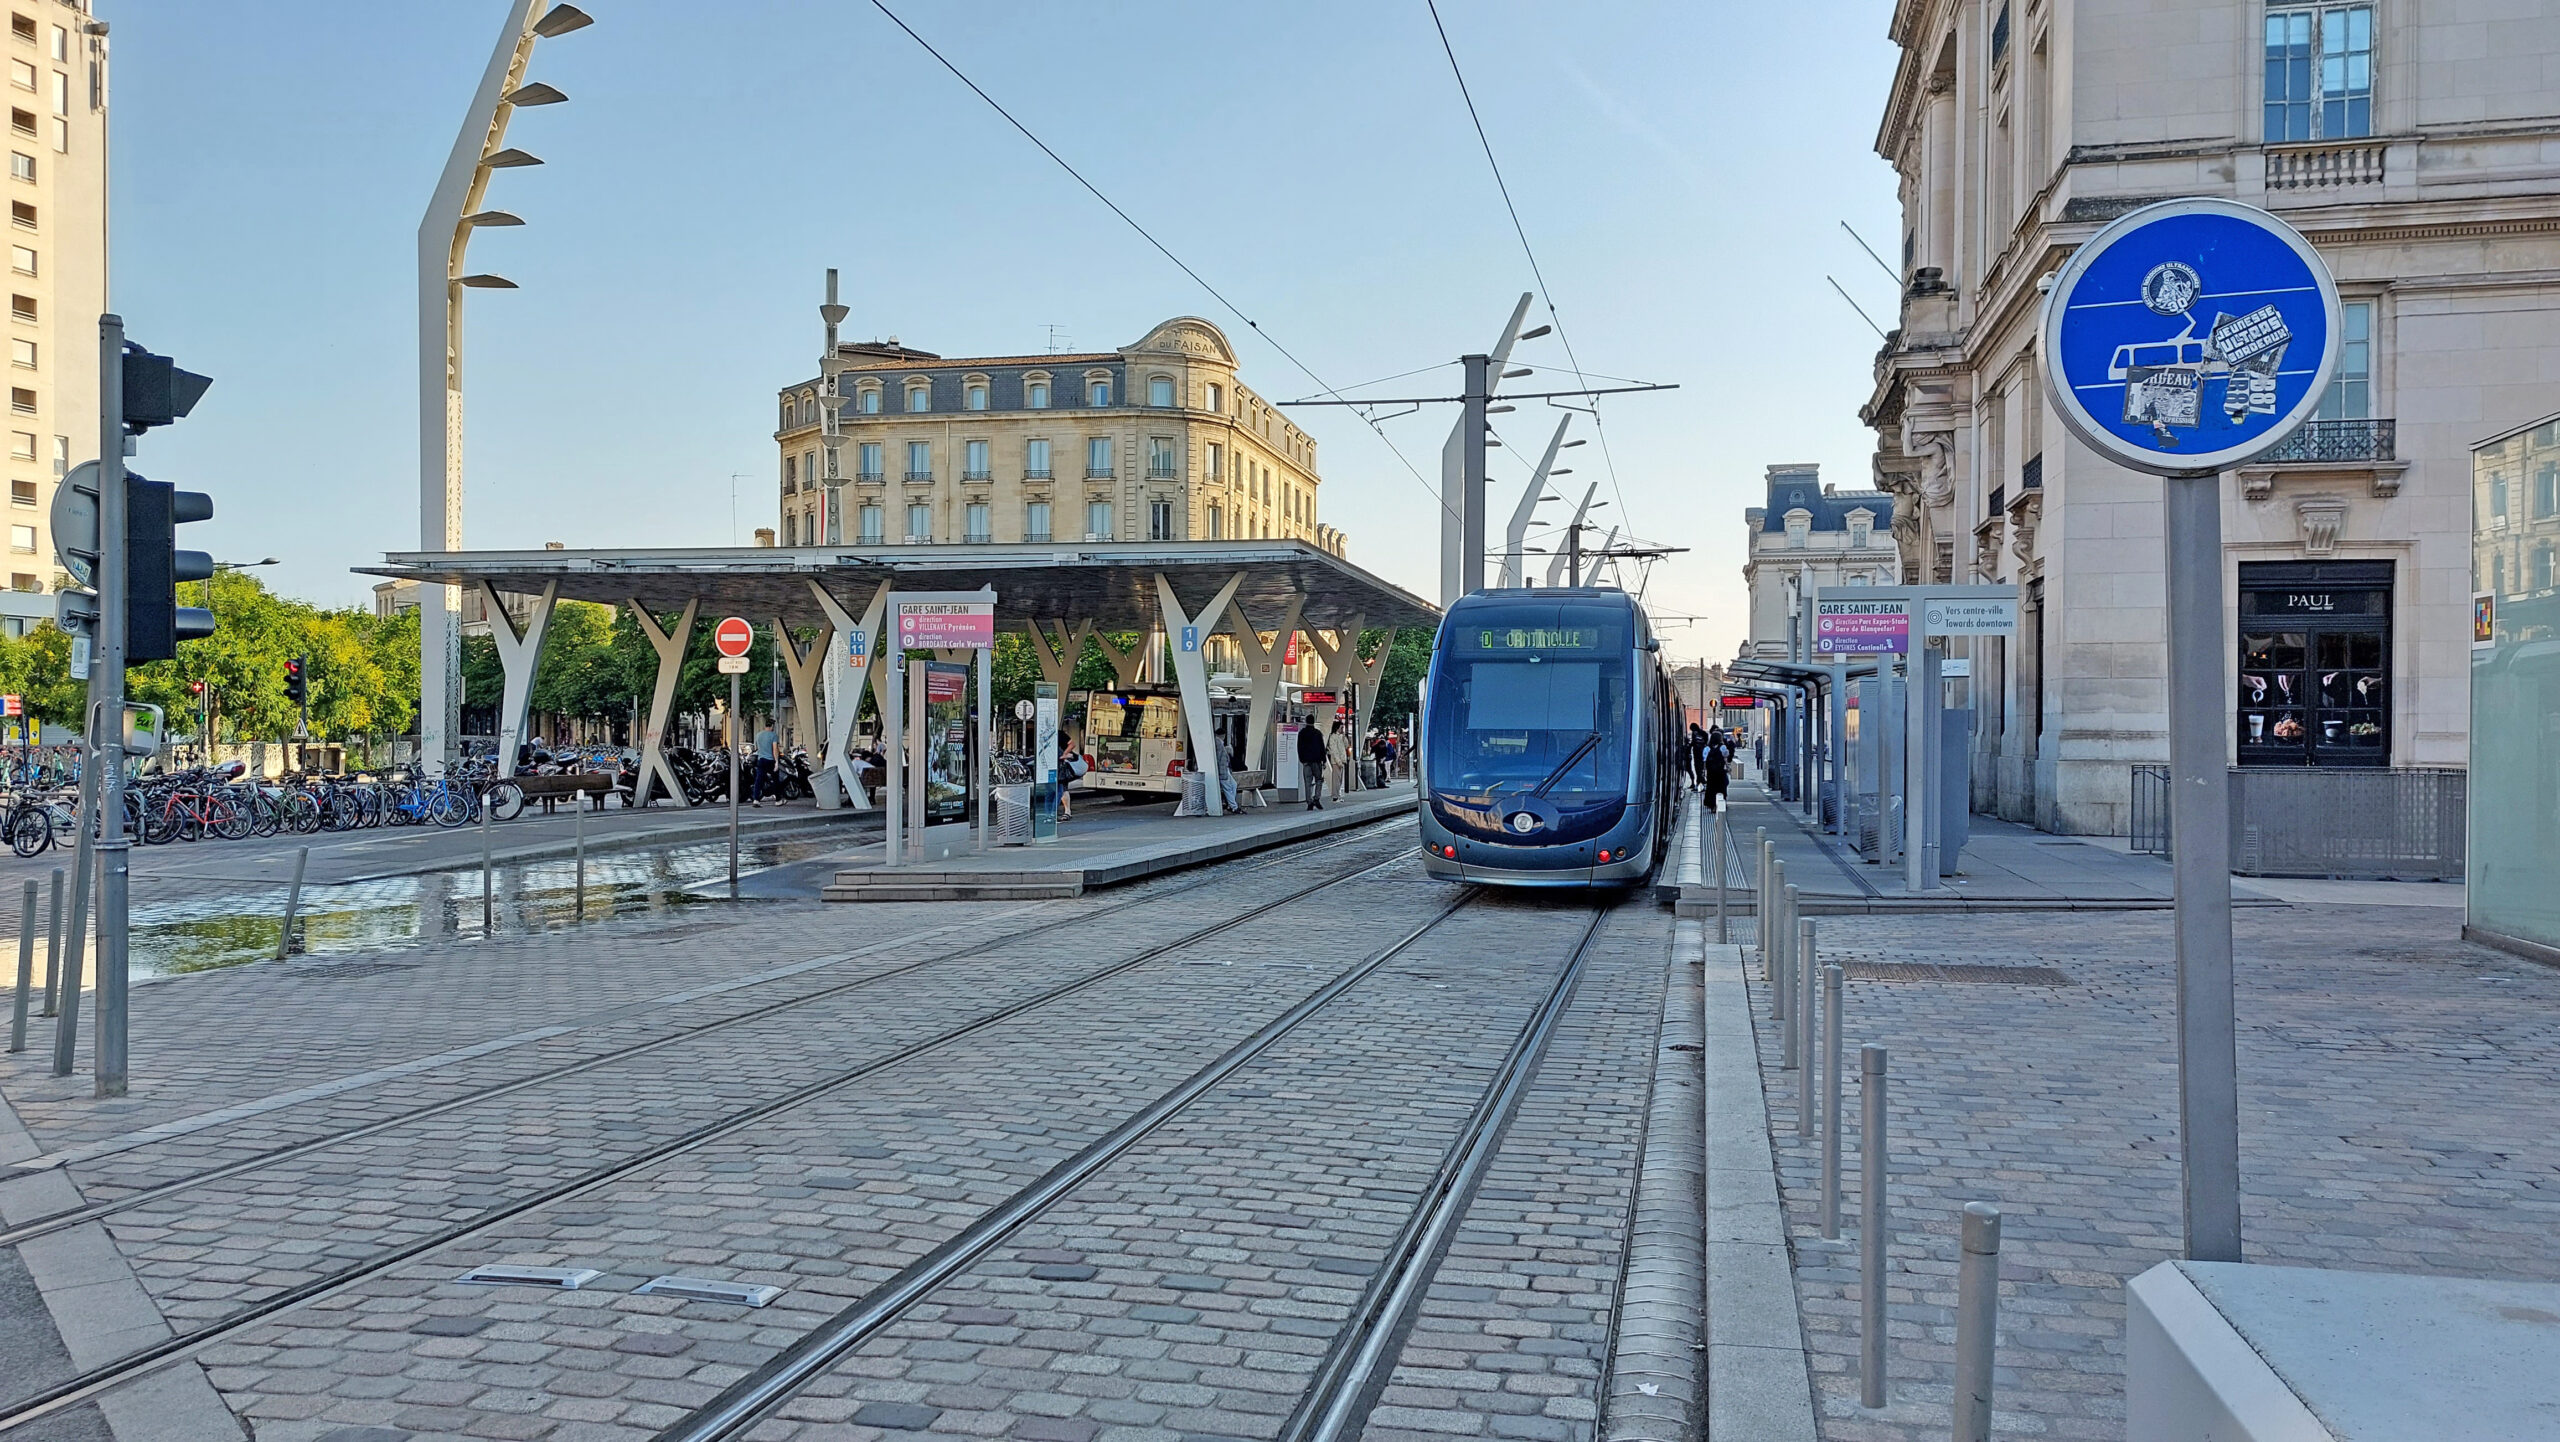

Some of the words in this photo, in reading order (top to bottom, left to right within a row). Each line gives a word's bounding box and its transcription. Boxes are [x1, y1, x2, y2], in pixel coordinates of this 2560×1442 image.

[2217, 306, 2275, 341] JEUNESSE
[2220, 316, 2282, 353] ULTRAS
[1174, 340, 1216, 354] FAISAN
[2228, 328, 2287, 362] BORDEAUX
[2288, 594, 2334, 606] PAUL
[902, 605, 922, 614] GARE
[925, 605, 969, 614] SAINT-JEAN
[1819, 604, 1845, 614] GARE
[1848, 604, 1903, 614] SAINT-JEAN
[1945, 606, 1961, 615] Vers
[1963, 605, 2003, 615] centre-ville
[1945, 618, 1974, 628] Towards
[1976, 618, 2013, 628] downtown
[851, 632, 864, 642] 10
[1186, 628, 1192, 639] 1
[851, 644, 863, 654] 11
[1186, 640, 1193, 651] 9
[1288, 644, 1296, 658] ibis
[851, 656, 864, 667] 31
